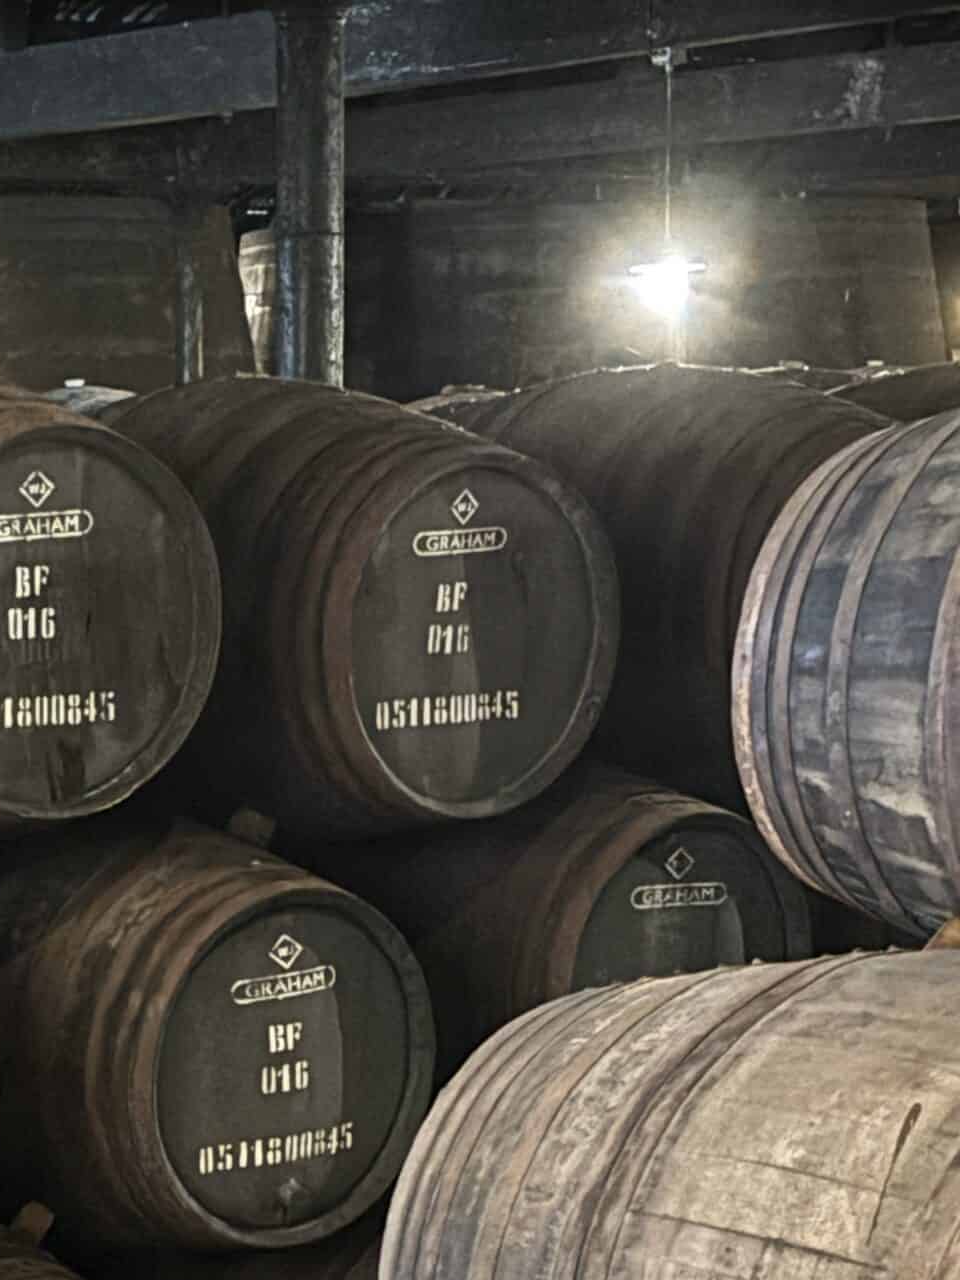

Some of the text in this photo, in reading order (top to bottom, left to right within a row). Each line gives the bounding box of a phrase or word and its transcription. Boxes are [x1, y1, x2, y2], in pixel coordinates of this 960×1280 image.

[426, 531, 496, 552] GRAHAM
[15, 565, 50, 598] BF
[436, 581, 468, 613] BF
[8, 607, 55, 640] 016
[427, 624, 470, 654] 016
[376, 690, 519, 730] 0511800845
[642, 887, 715, 905] GRAHAM
[244, 969, 325, 998] GRAHAM
[268, 1022, 303, 1053] BF
[260, 1060, 309, 1094] 016
[199, 1122, 353, 1175] 0511800845
